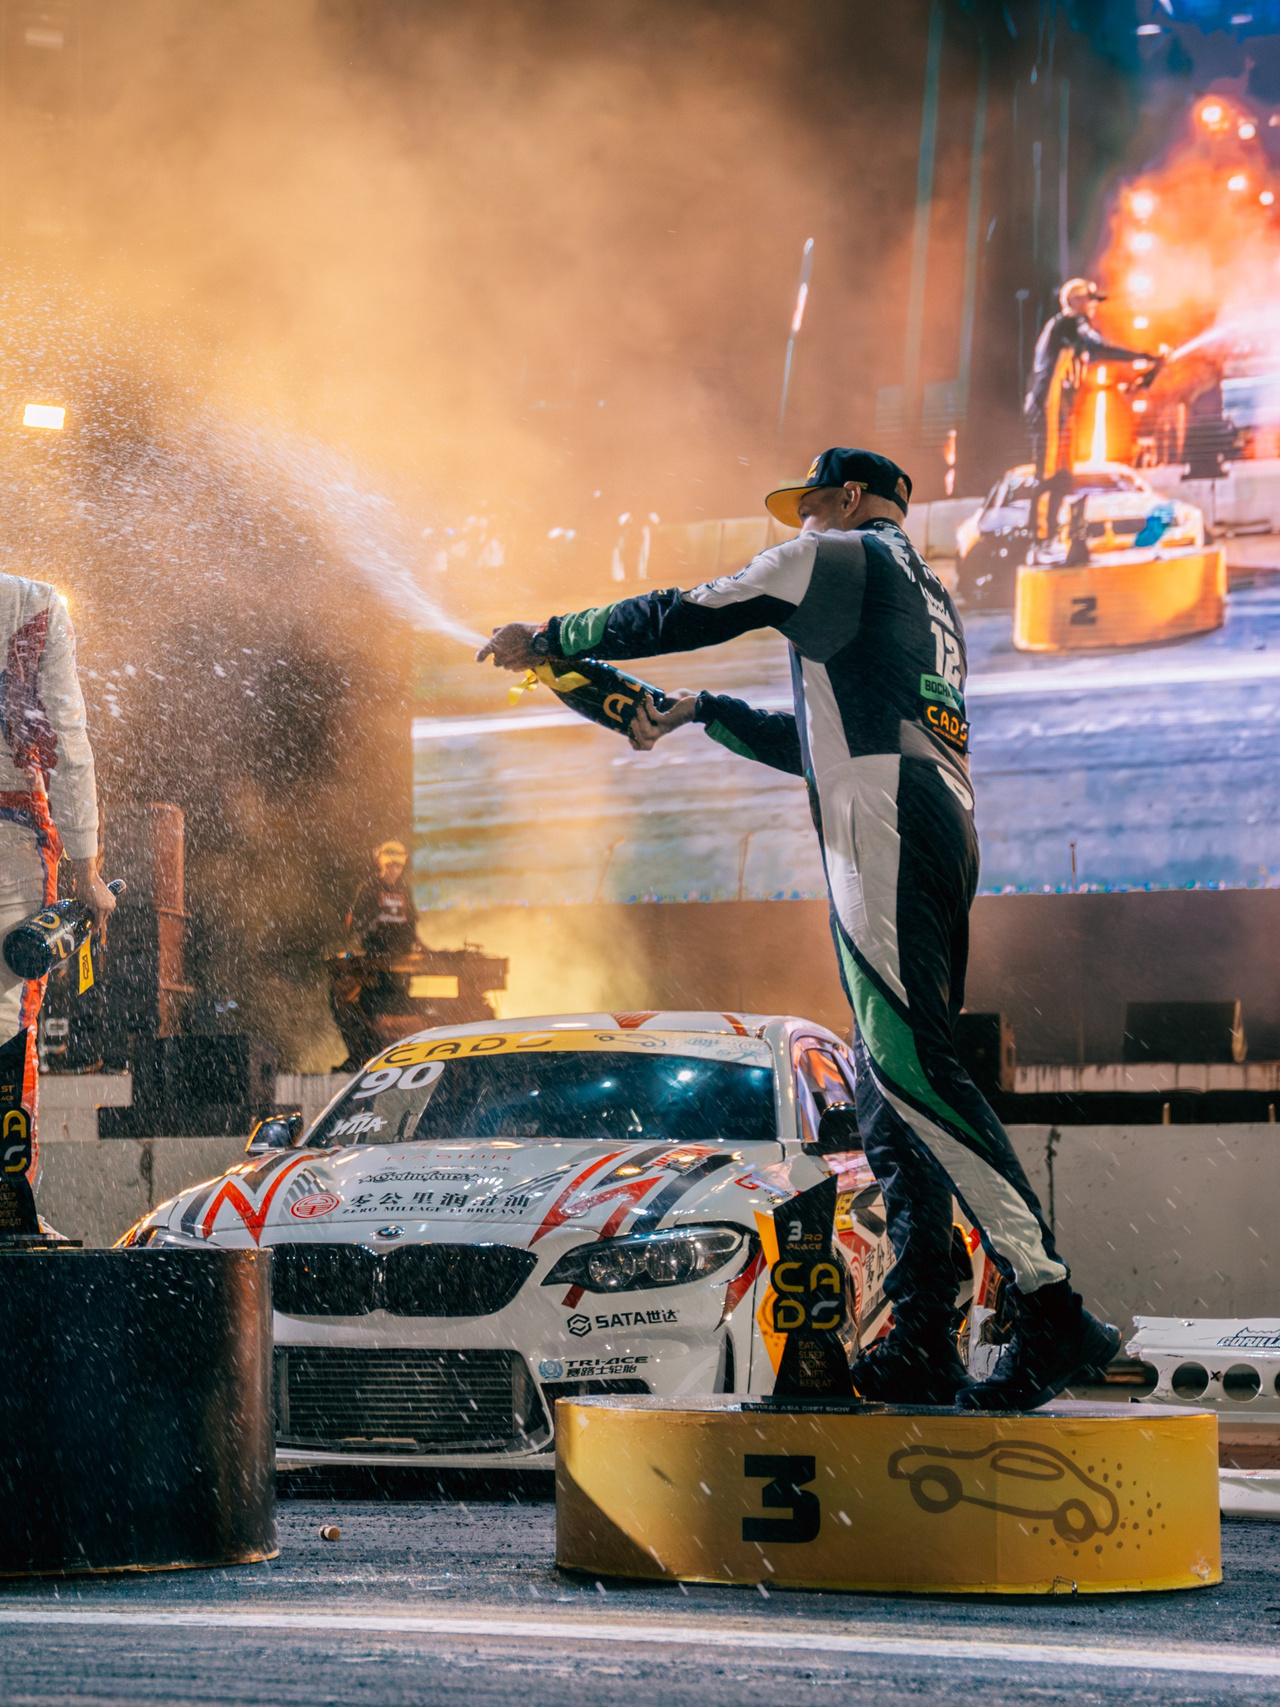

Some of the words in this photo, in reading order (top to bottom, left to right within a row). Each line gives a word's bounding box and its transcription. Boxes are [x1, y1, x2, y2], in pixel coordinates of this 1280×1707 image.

[1070, 597, 1097, 626] 2
[930, 620, 962, 692] 12
[926, 705, 968, 742] CADS
[383, 1034, 557, 1064] CADS
[352, 1060, 446, 1100] 90
[383, 1205, 441, 1213] MILEAGE
[565, 1356, 649, 1367] TRI-ACE
[566, 1364, 637, 1378] 赛路士轮胎
[741, 1454, 821, 1543] 3
